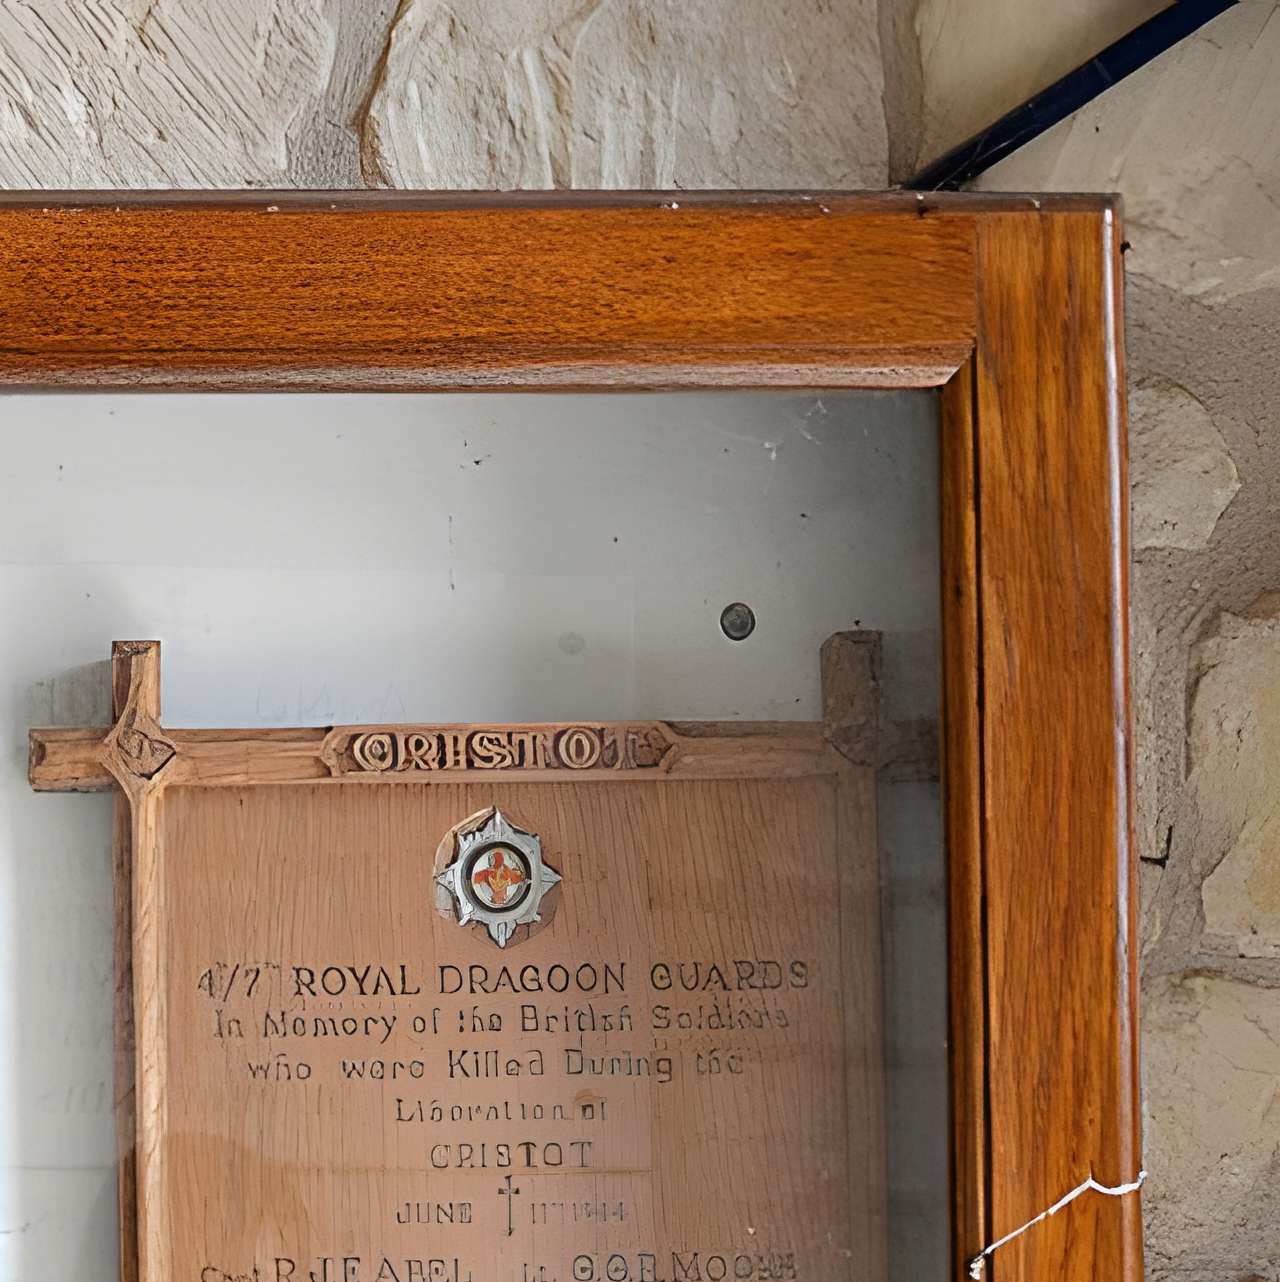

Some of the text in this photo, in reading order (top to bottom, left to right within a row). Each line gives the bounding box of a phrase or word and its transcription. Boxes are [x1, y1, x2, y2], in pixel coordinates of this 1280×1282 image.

[352, 728, 640, 770] CRISTOT
[293, 965, 421, 996] ROYAL
[439, 963, 626, 994] DRAGOON
[650, 960, 810, 993] GUARDS
[213, 1009, 242, 1038] In
[263, 1010, 397, 1044] Memory
[520, 1004, 633, 1033] British
[248, 1053, 312, 1081] who
[342, 1059, 425, 1080] were
[447, 1049, 544, 1079] Killed
[564, 1049, 673, 1083] During
[395, 1098, 566, 1122] Liberation
[430, 1141, 593, 1169] CRISTOT
[396, 1202, 472, 1224] JUNE
